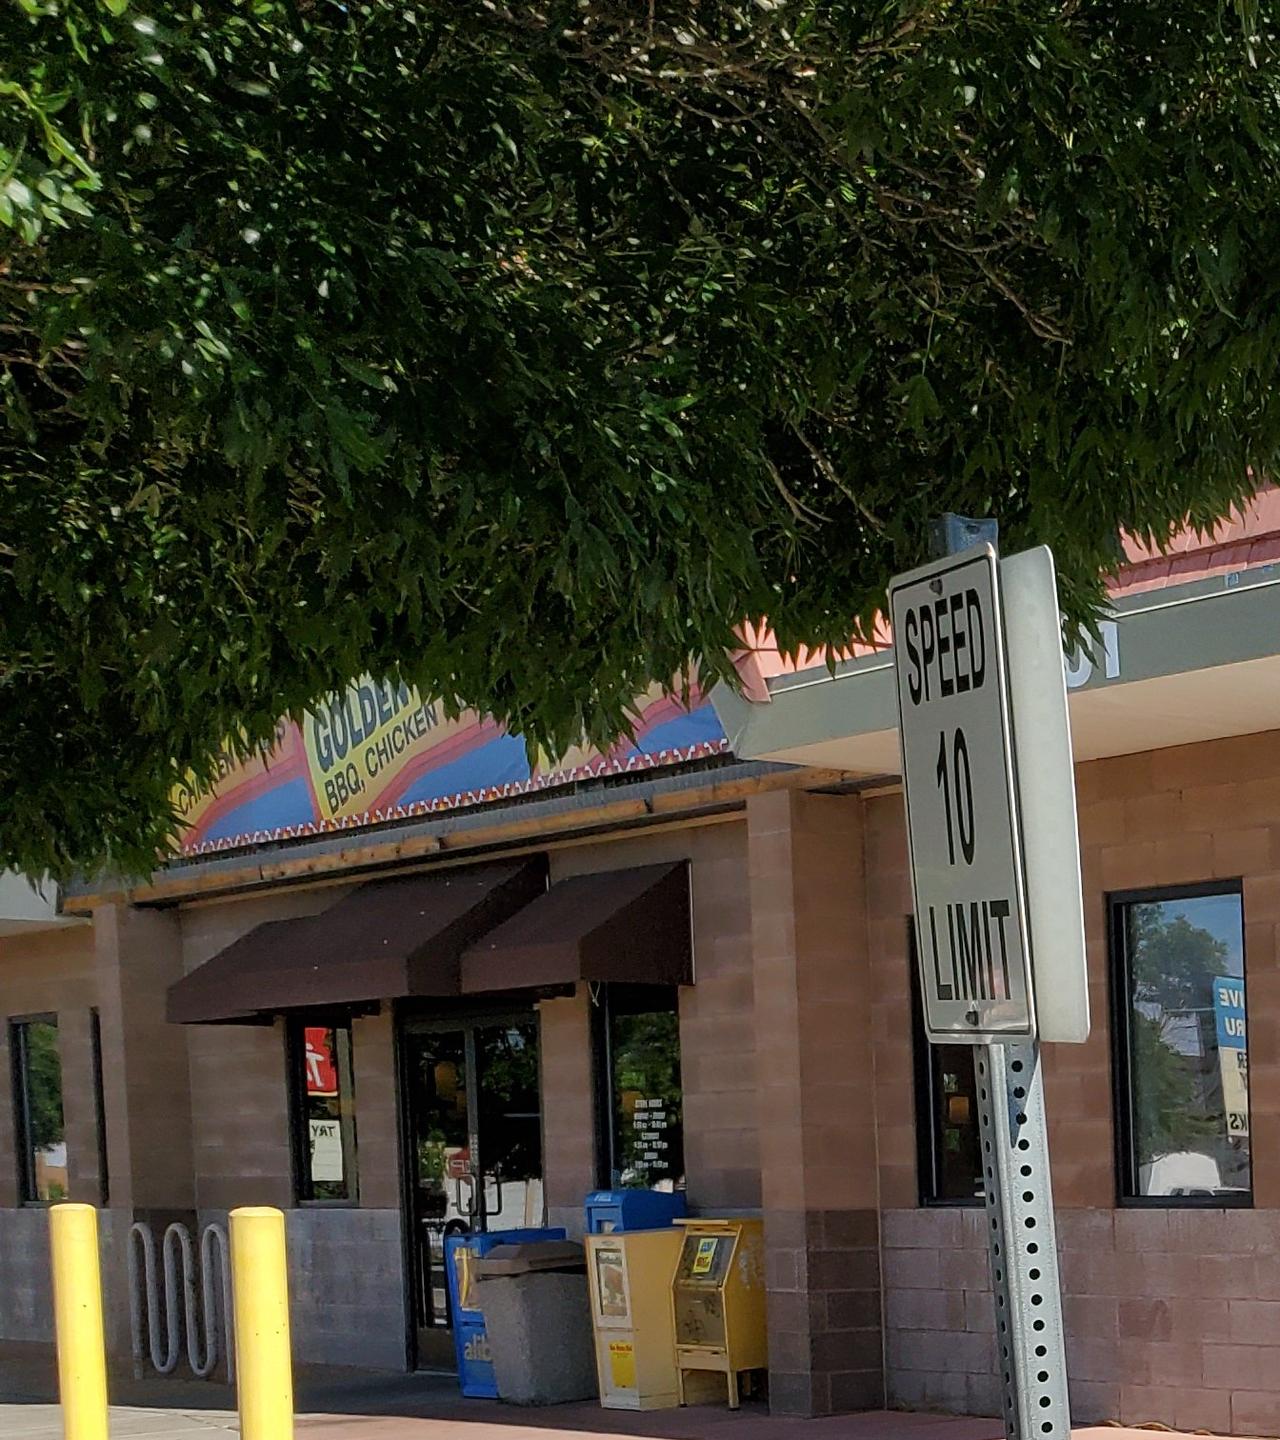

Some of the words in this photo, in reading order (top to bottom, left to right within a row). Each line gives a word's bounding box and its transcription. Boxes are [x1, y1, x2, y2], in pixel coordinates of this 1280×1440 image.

[905, 588, 986, 706] SPEED
[324, 762, 365, 815] BBQ,
[365, 703, 438, 777] CHICKEN
[937, 728, 975, 866] 10
[929, 900, 1012, 1000] LIMIT
